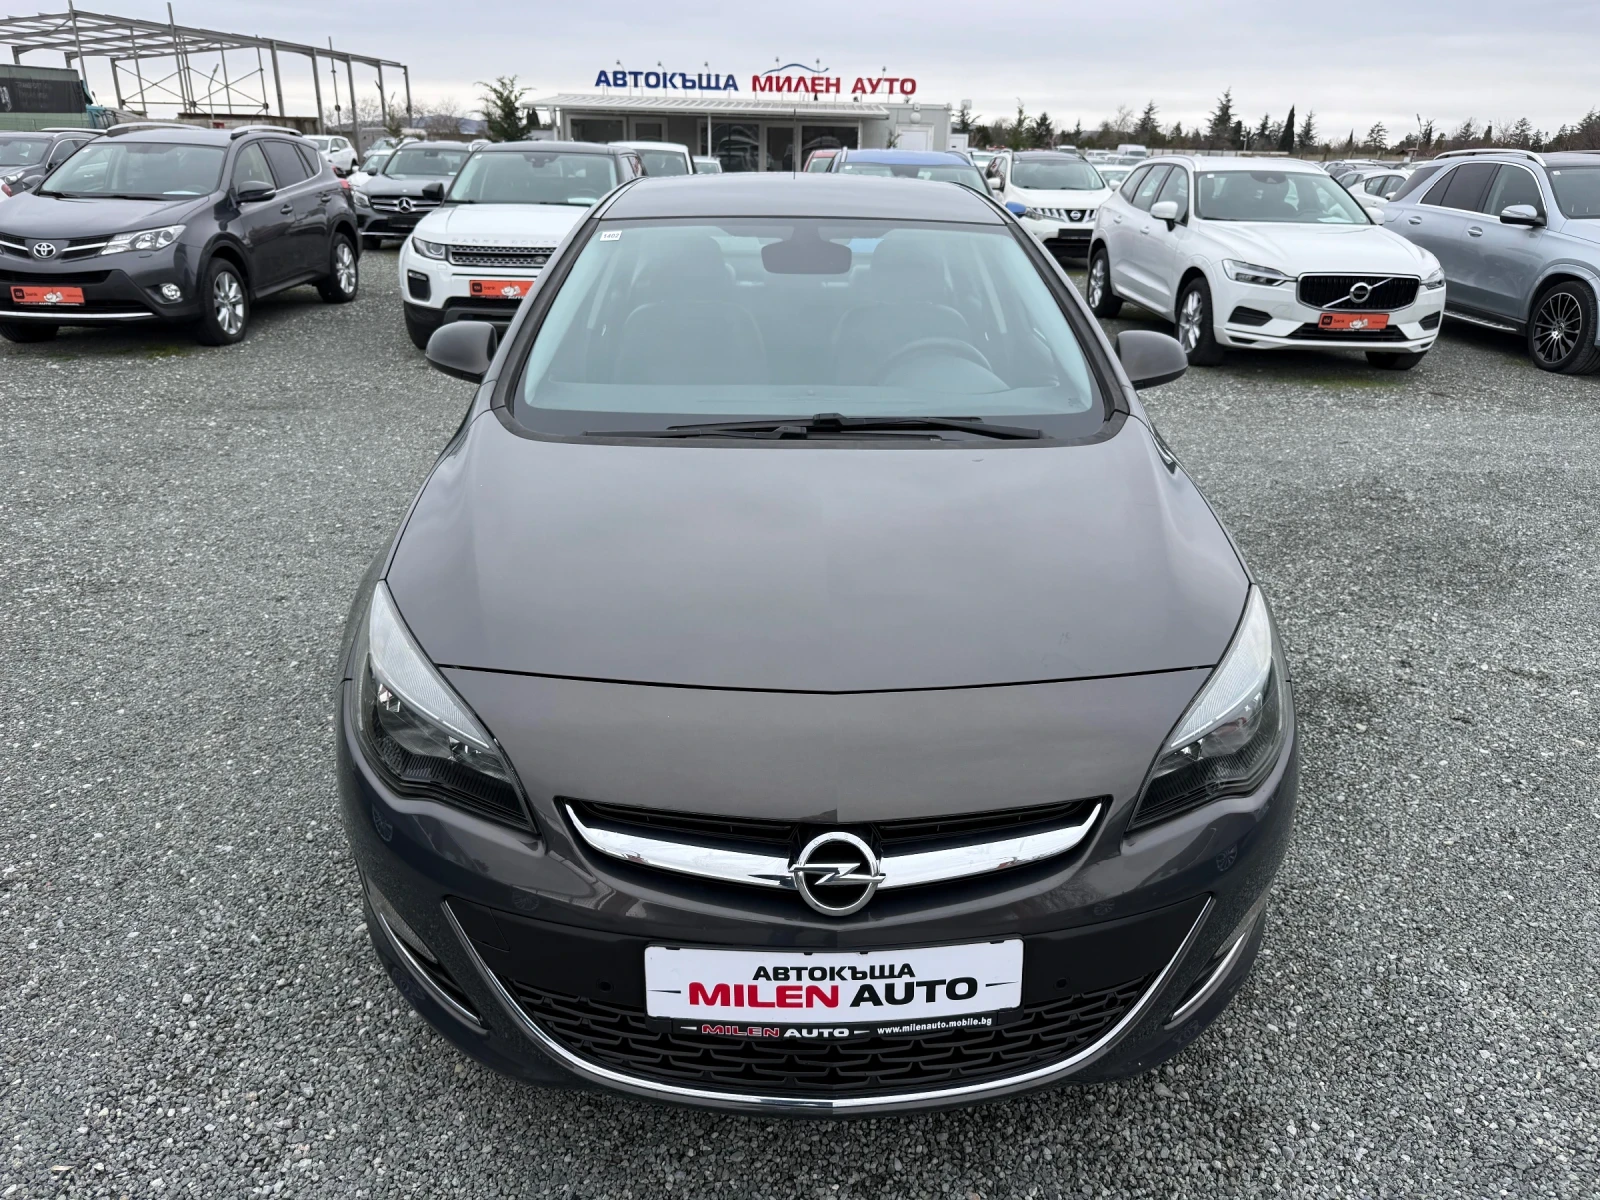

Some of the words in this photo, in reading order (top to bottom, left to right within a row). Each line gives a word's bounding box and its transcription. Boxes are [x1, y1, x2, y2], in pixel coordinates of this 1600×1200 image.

[595, 70, 739, 92] АВТОКЪЩА
[752, 75, 841, 94] МИЛЕН
[851, 77, 917, 95] АУТО
[752, 963, 916, 981] АВТОКЪЩА
[688, 982, 839, 1008] MILEN
[849, 977, 978, 1008] AUTO
[701, 1024, 780, 1037] MILEN
[783, 1028, 850, 1038] AUTO
[877, 1017, 992, 1035] www.milenauto.mobile.bg
